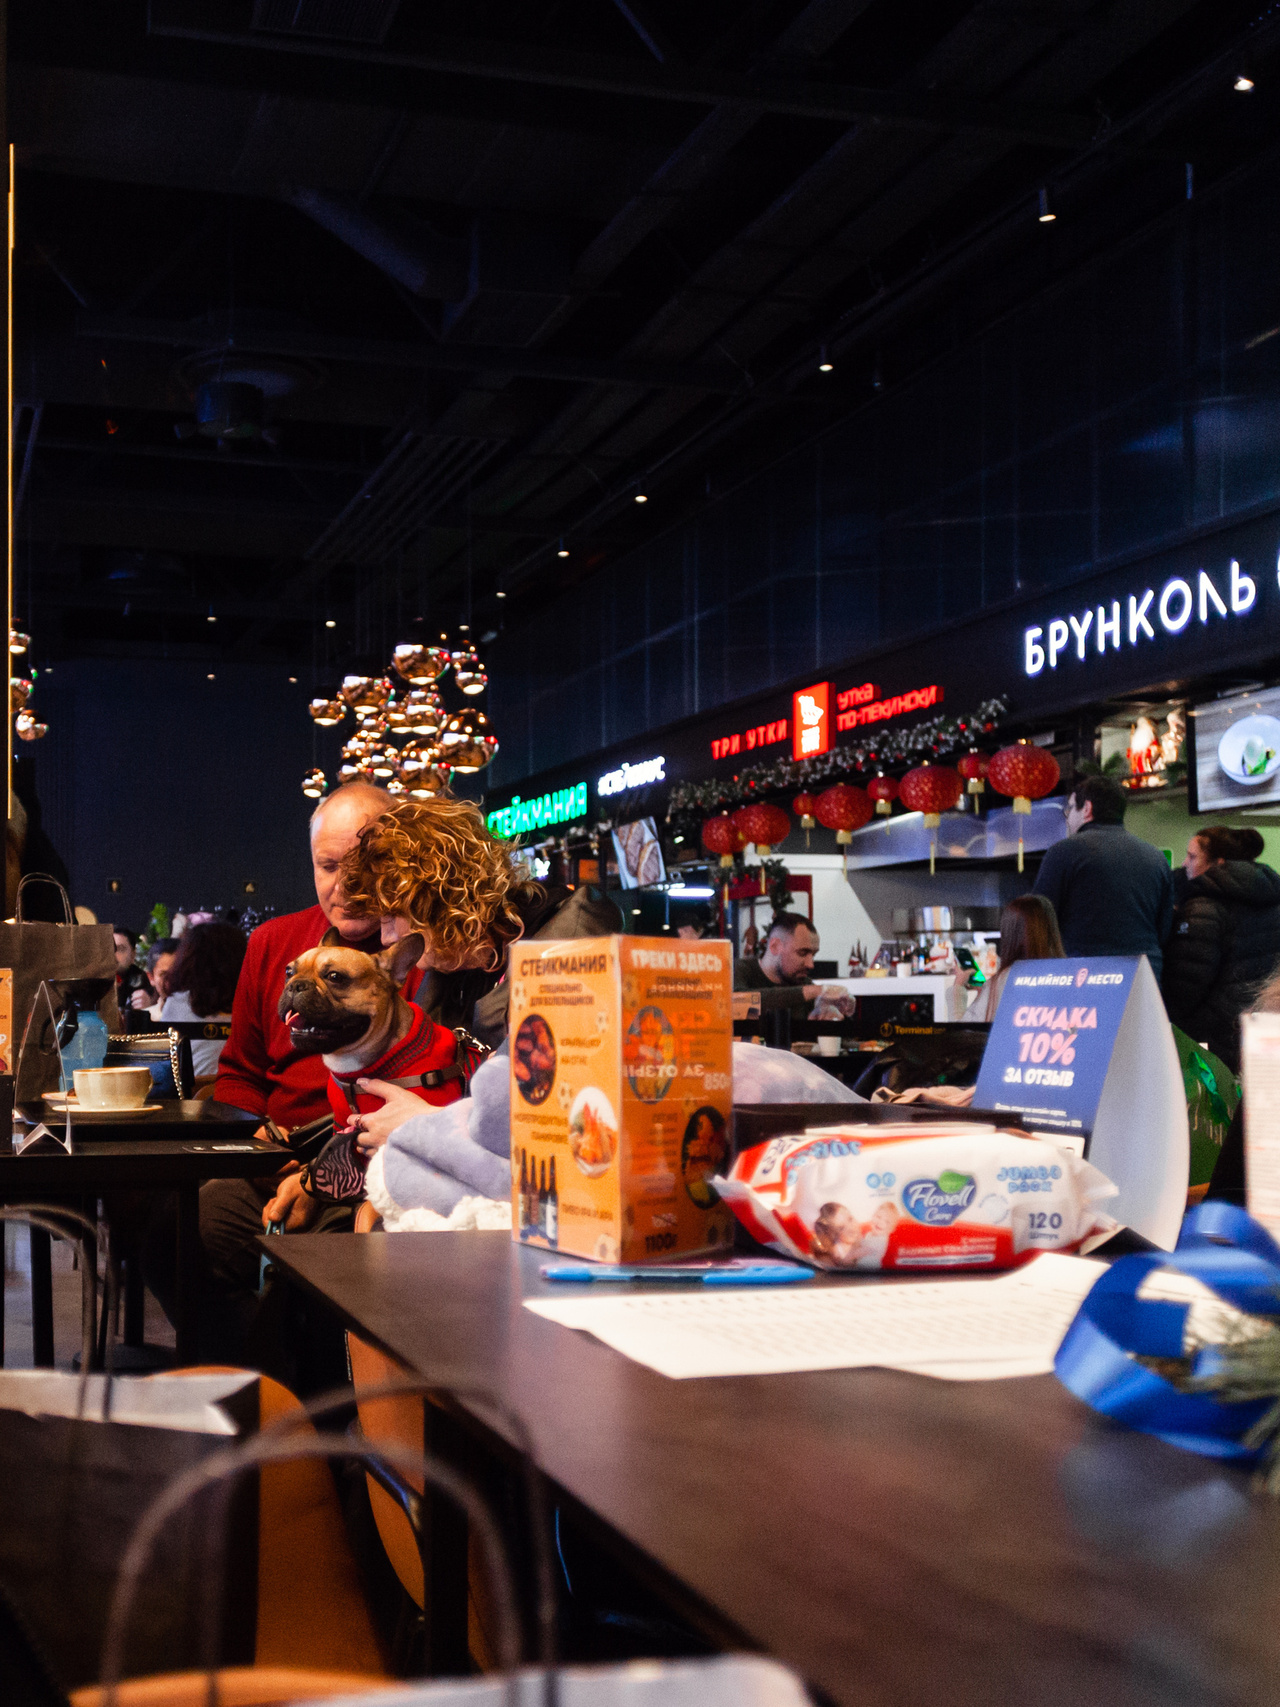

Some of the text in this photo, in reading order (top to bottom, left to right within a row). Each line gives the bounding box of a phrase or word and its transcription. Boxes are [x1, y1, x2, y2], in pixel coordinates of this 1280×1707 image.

[711, 733, 741, 760] ТРИ
[745, 718, 788, 750] УТКИ
[487, 781, 588, 839] СТЕЙКМАНИЯ
[1014, 973, 1124, 987] МИДИЙНОЕ МЕСТО
[894, 1024, 933, 1035] Terminal
[1013, 1005, 1098, 1030] СКИДКА
[1018, 1032, 1078, 1066] 10%
[1004, 1067, 1075, 1087] ЗА ОТЗЫВ
[908, 1184, 975, 1209] Flovell
[1028, 1211, 1062, 1230] 120
